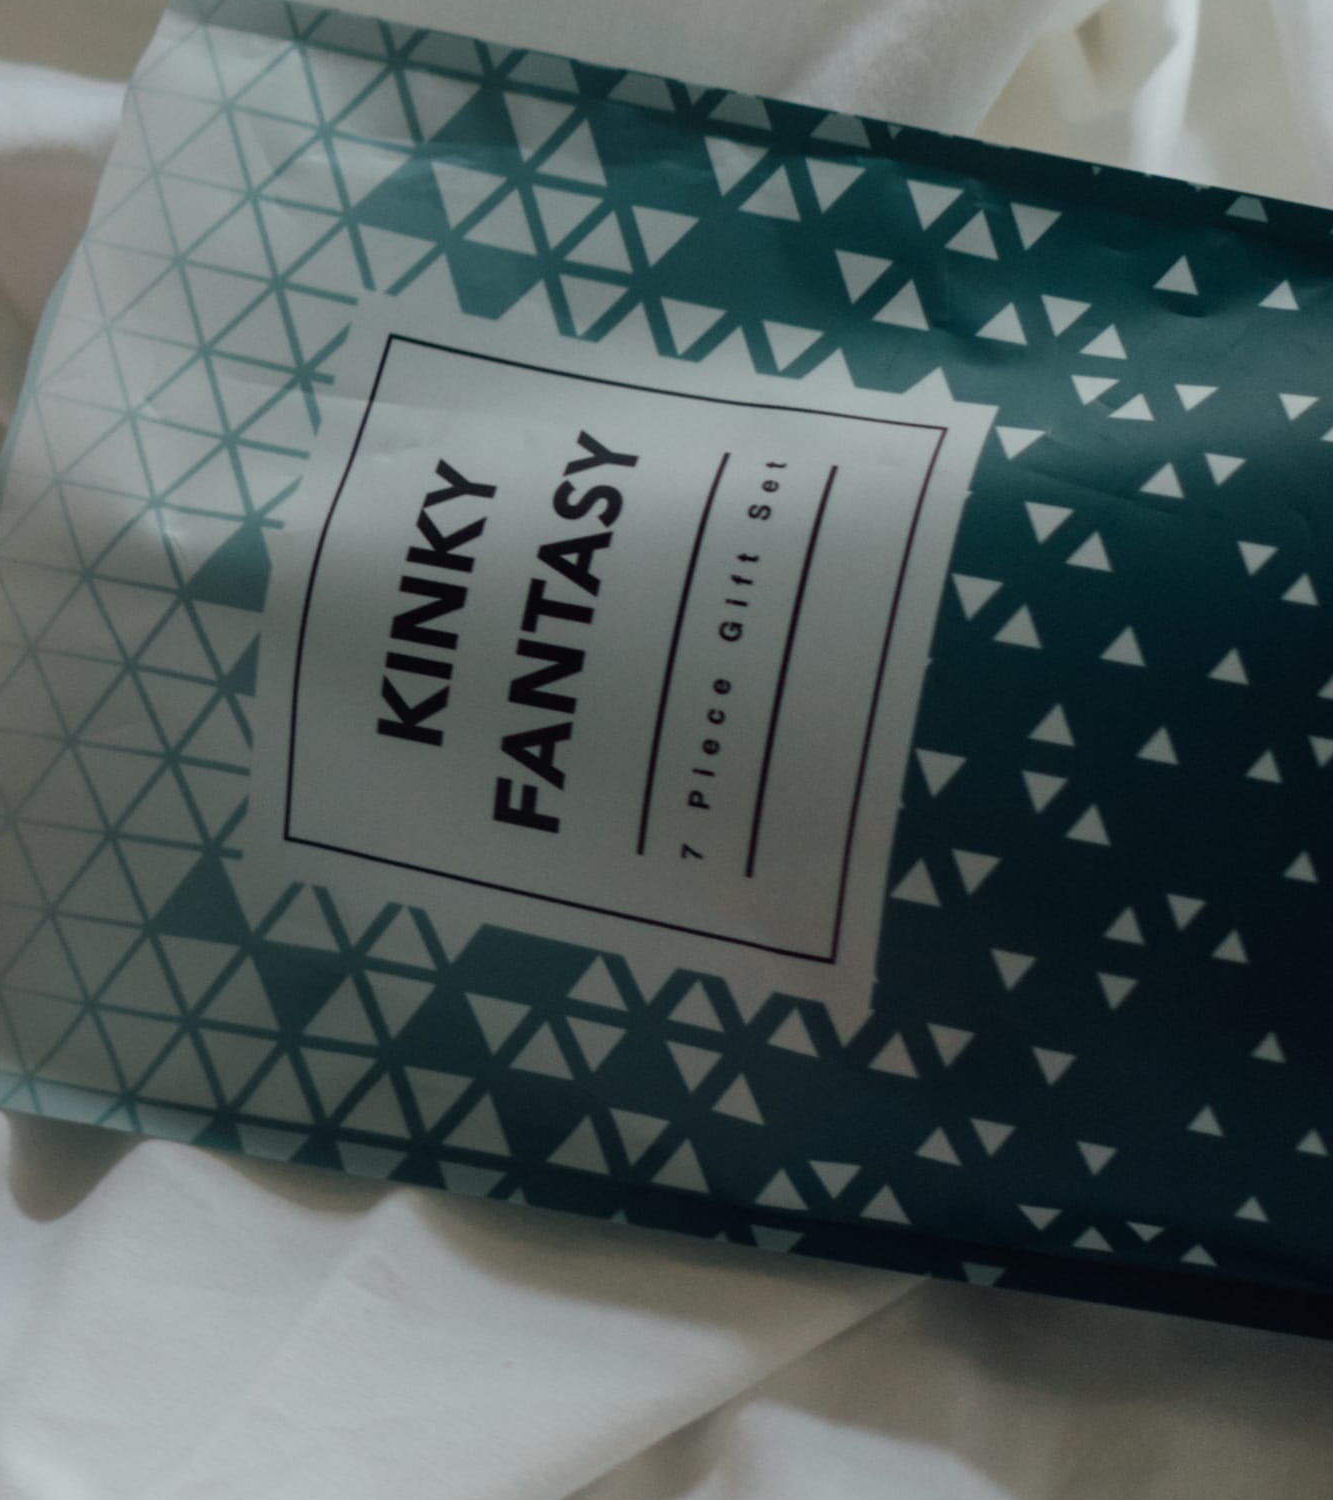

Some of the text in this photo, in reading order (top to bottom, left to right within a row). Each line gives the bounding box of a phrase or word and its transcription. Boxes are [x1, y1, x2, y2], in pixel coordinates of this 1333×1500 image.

[375, 458, 499, 748] KINKY
[491, 429, 640, 835] FANTASY
[679, 460, 788, 862] 7 Piece Gift Set
